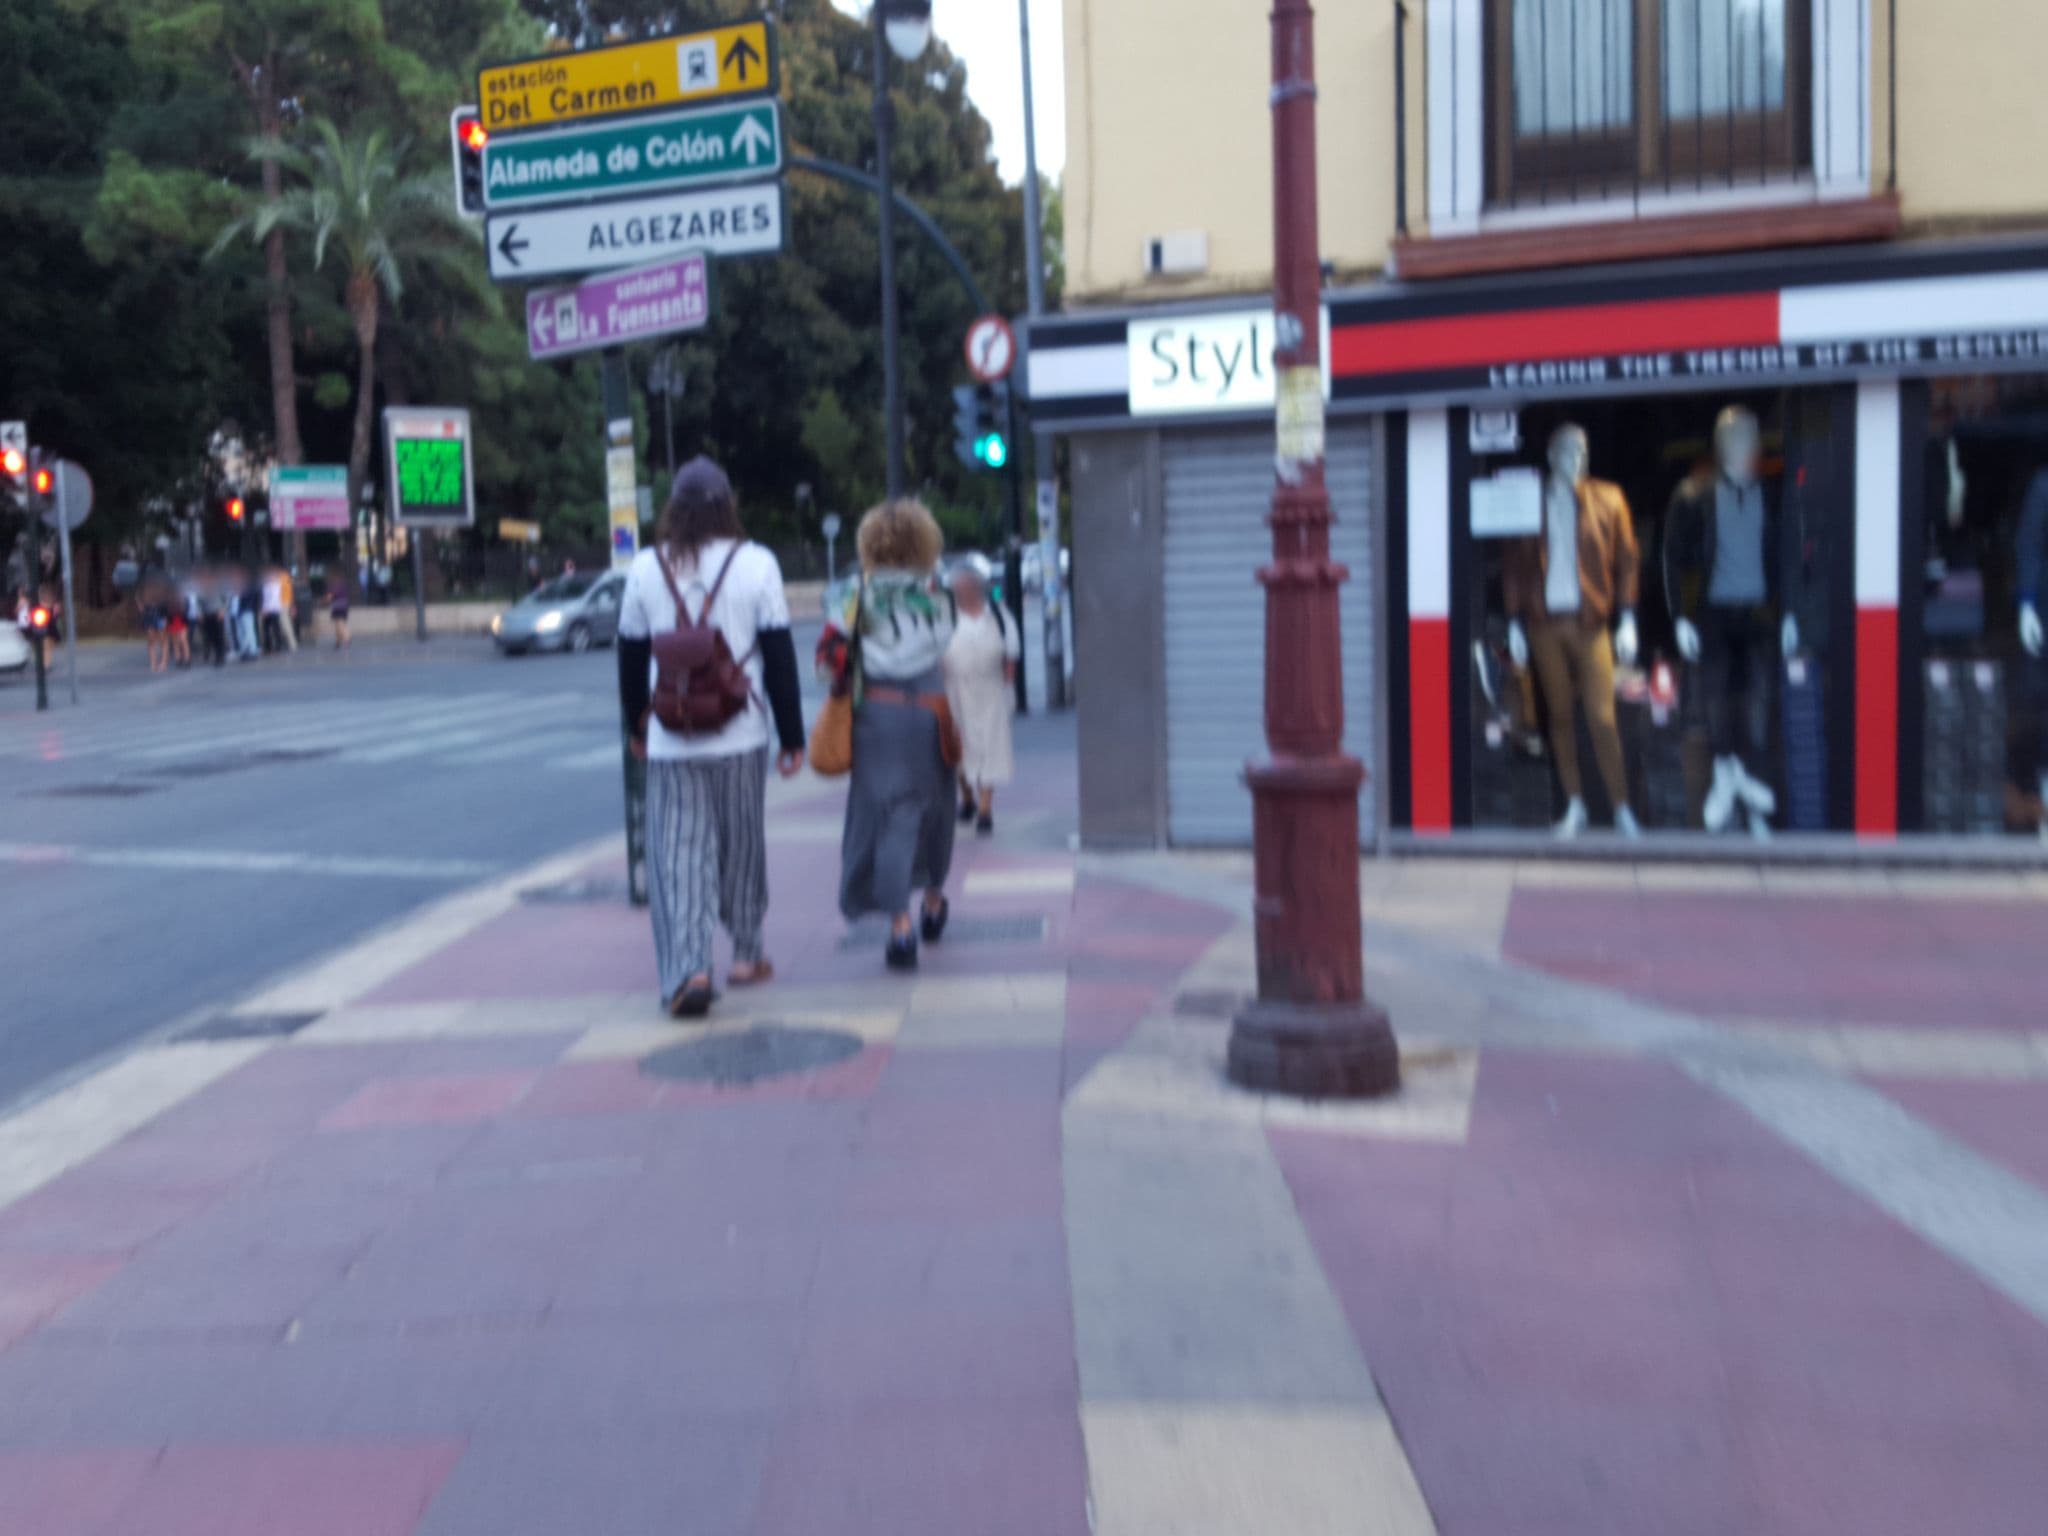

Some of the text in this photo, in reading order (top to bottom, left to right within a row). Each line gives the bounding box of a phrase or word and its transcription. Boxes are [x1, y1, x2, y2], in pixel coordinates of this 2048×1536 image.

[488, 66, 567, 93] estación
[489, 80, 656, 124] Del Carmen
[489, 130, 725, 187] Alameda de Colón
[588, 203, 771, 251] ALGEZARES
[607, 290, 704, 334] Fuensanta
[1151, 322, 1276, 394] Styl
[1619, 354, 1672, 379] THE
[1868, 338, 1919, 364] THE
